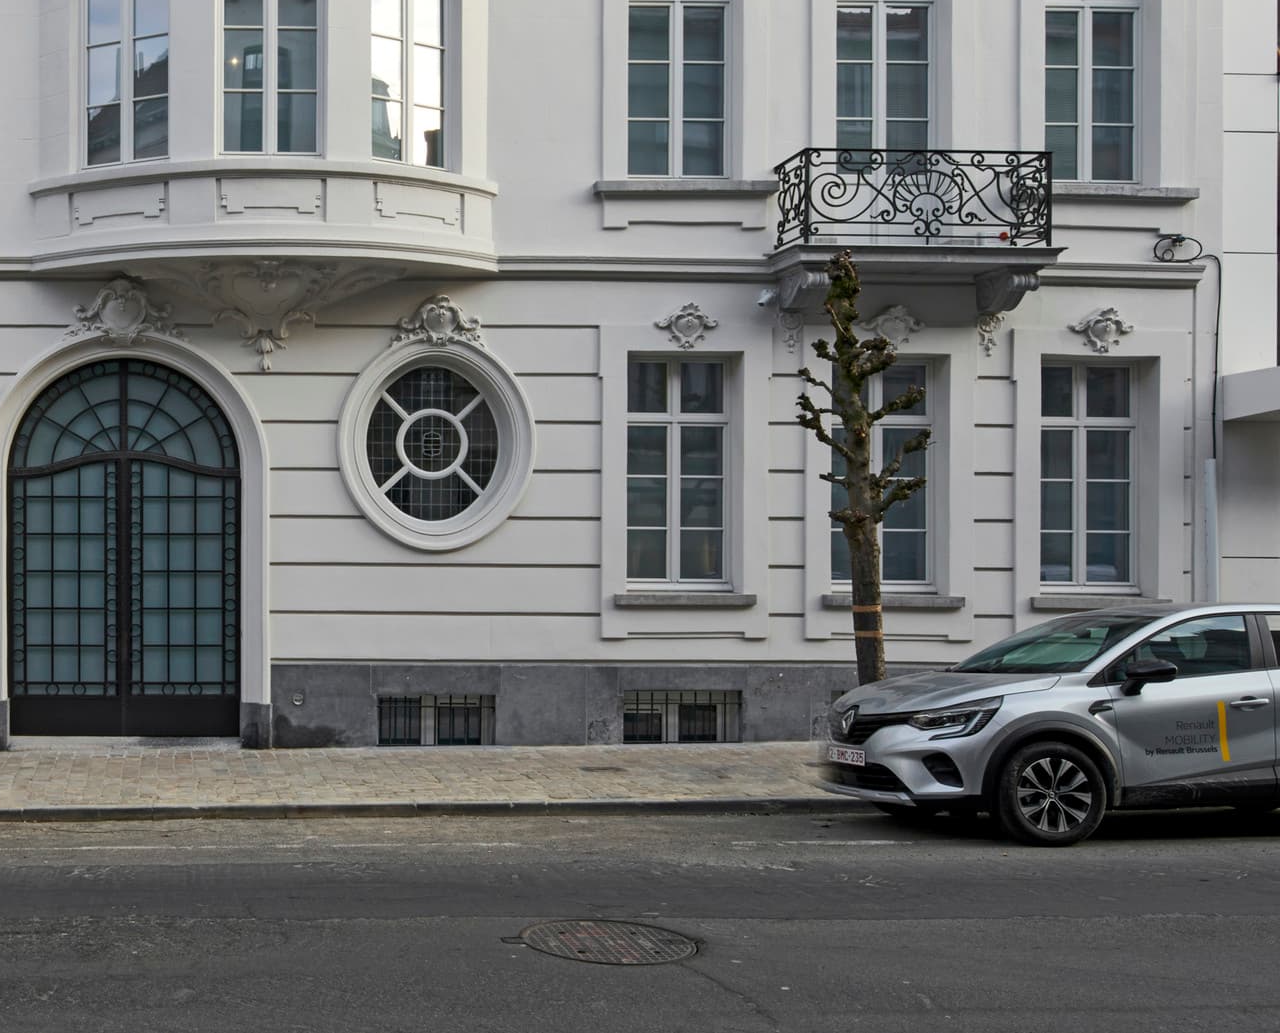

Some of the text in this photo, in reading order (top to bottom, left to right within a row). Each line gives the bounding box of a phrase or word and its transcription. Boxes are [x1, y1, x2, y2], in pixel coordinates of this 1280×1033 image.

[1176, 720, 1214, 730] Renault
[1165, 734, 1216, 745] MOBILITY
[1145, 747, 1155, 758] by
[1186, 745, 1218, 754] Brussels
